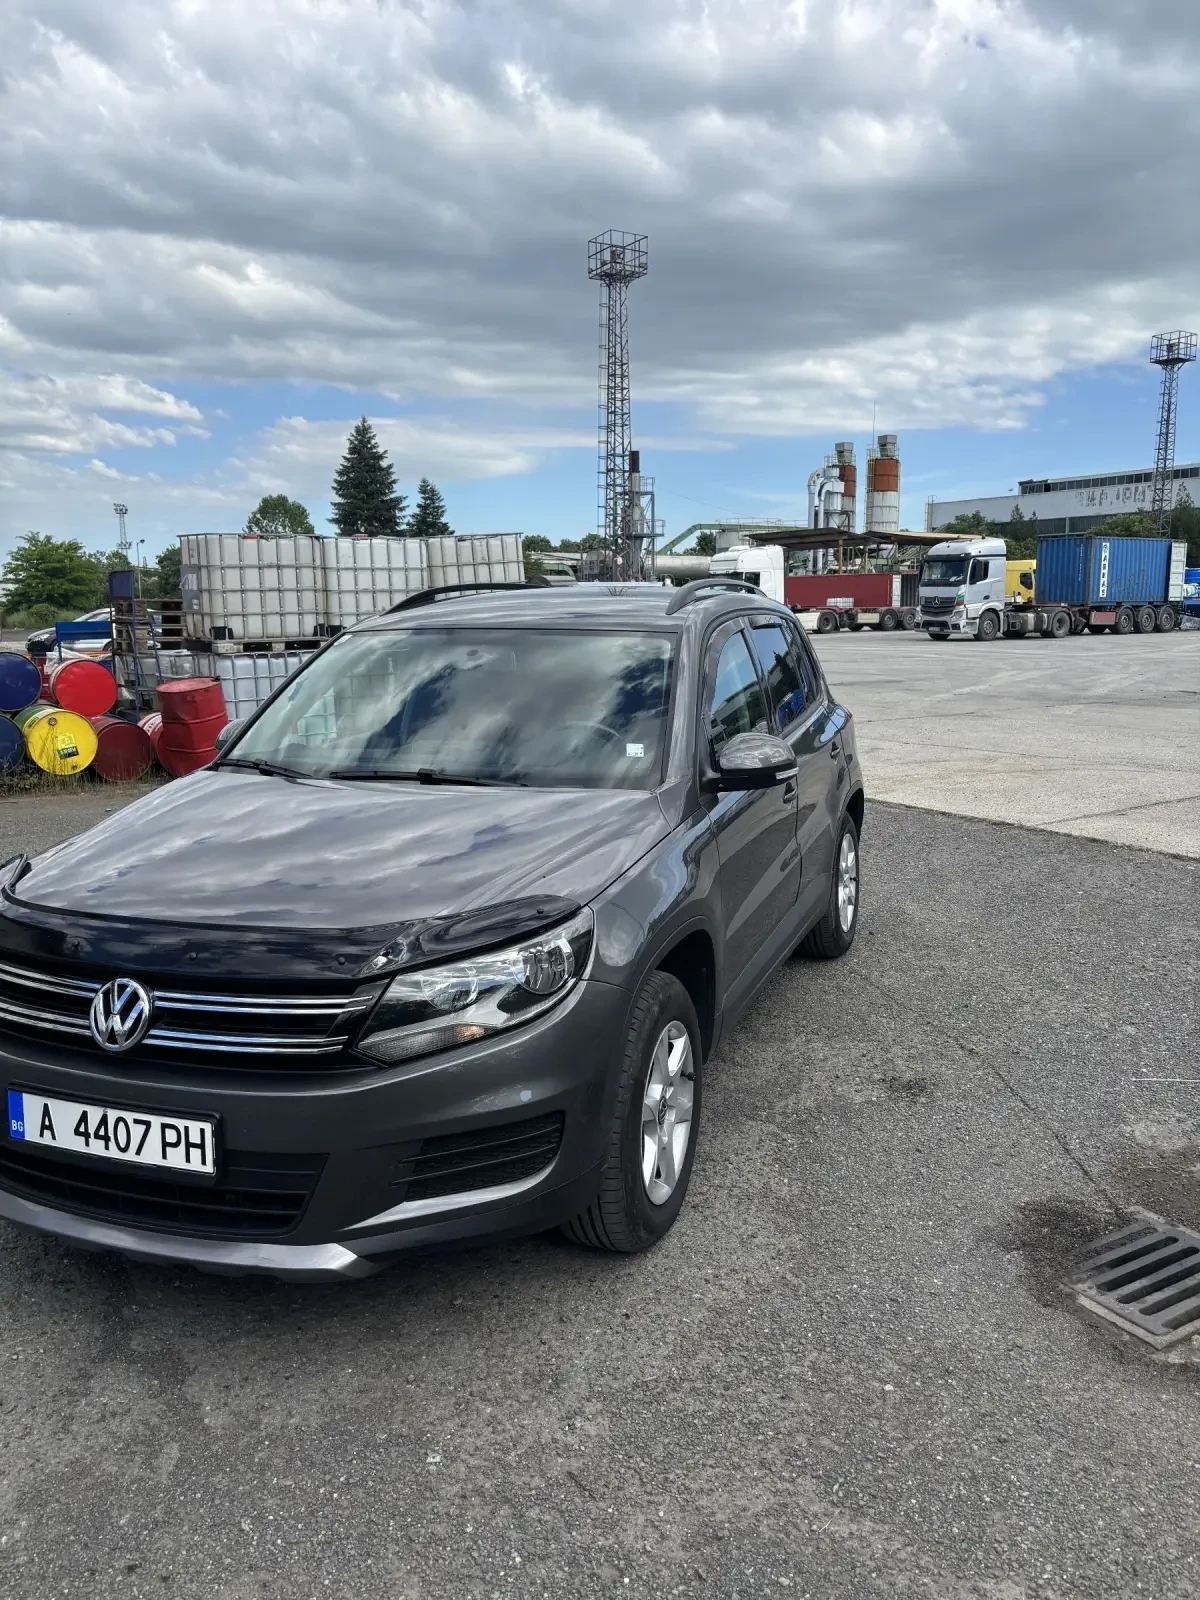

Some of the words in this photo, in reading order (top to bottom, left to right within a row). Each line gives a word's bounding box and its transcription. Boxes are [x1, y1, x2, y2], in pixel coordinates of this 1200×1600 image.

[91, 979, 149, 1050] VW
[11, 1119, 24, 1132] BG
[39, 1102, 57, 1141] A
[73, 1110, 152, 1156] 4407
[160, 1122, 207, 1166] PH
